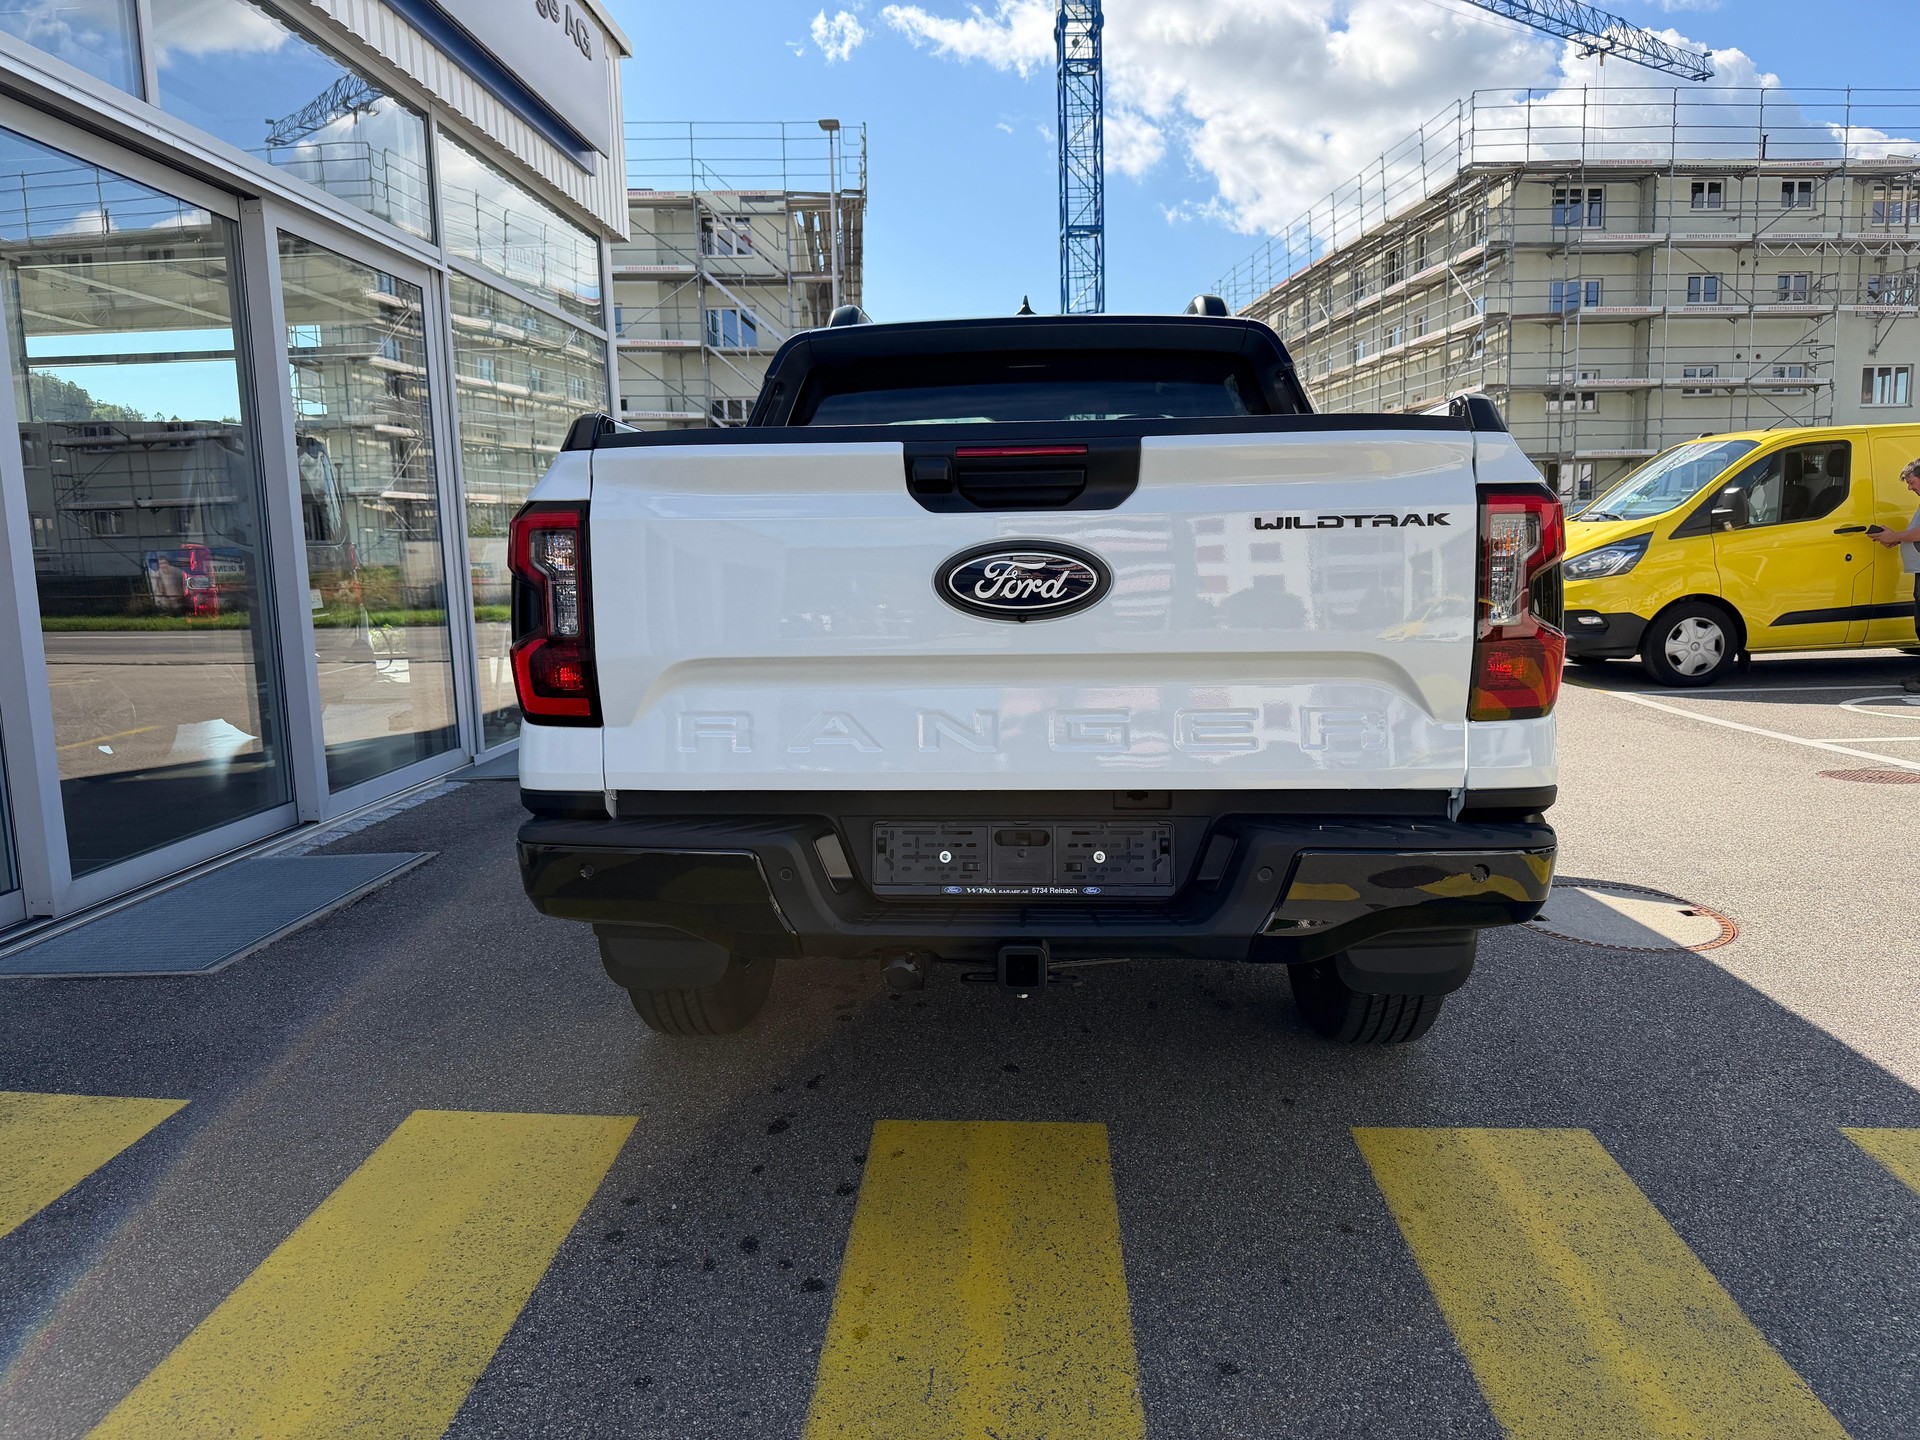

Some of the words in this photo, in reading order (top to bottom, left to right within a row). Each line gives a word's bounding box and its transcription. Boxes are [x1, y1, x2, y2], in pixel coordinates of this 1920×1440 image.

[565, 4, 592, 61] AG
[1254, 512, 1451, 530] WILDTRAK
[974, 560, 1070, 599] Ford
[678, 707, 1388, 753] RANGER
